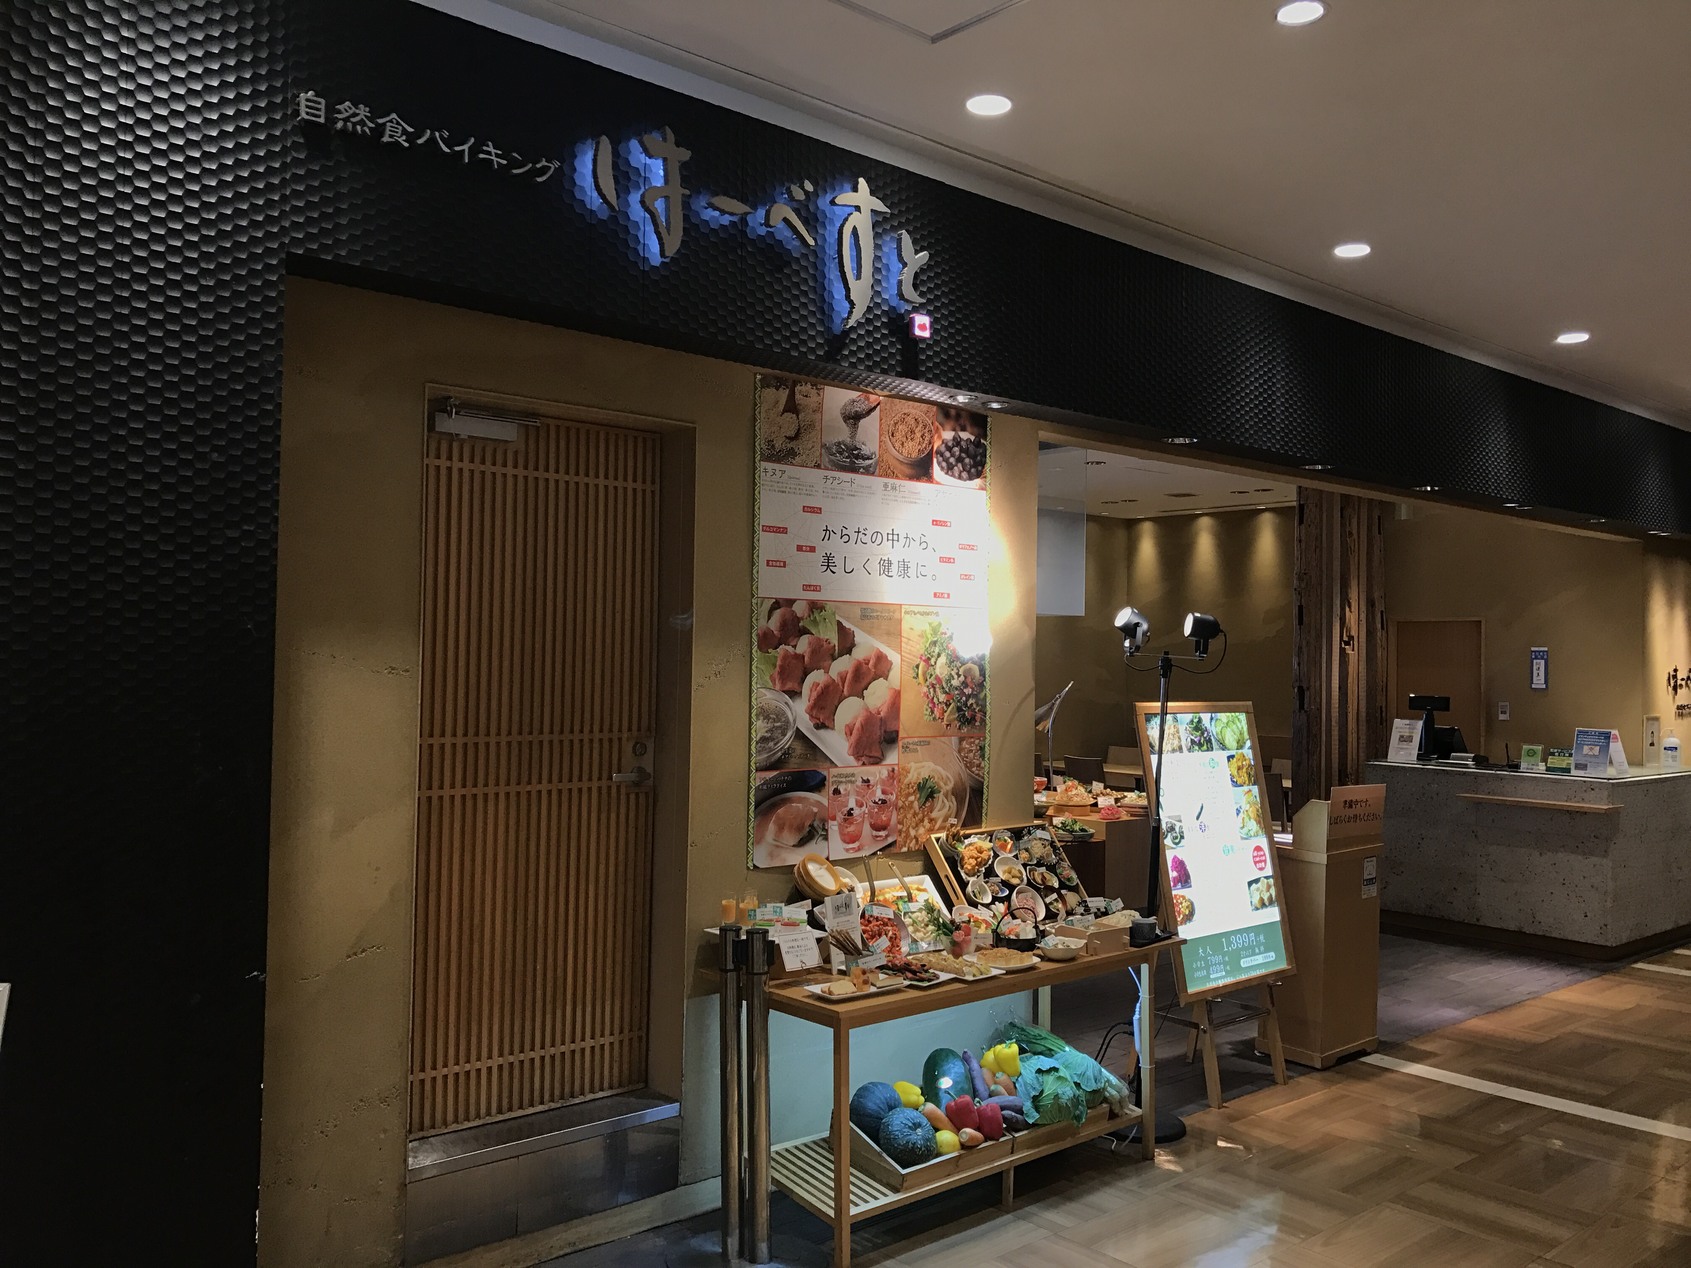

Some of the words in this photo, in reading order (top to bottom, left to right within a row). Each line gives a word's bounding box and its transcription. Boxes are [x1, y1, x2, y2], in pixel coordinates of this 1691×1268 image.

[296, 89, 560, 184] 自然食バイキング
[591, 125, 930, 330] はーべすと
[762, 467, 786, 479] キヌア
[822, 474, 856, 488] チアシード
[820, 524, 938, 554] からだの中から、
[820, 551, 938, 582] 美しく健康に。
[1198, 945, 1212, 957] 大人
